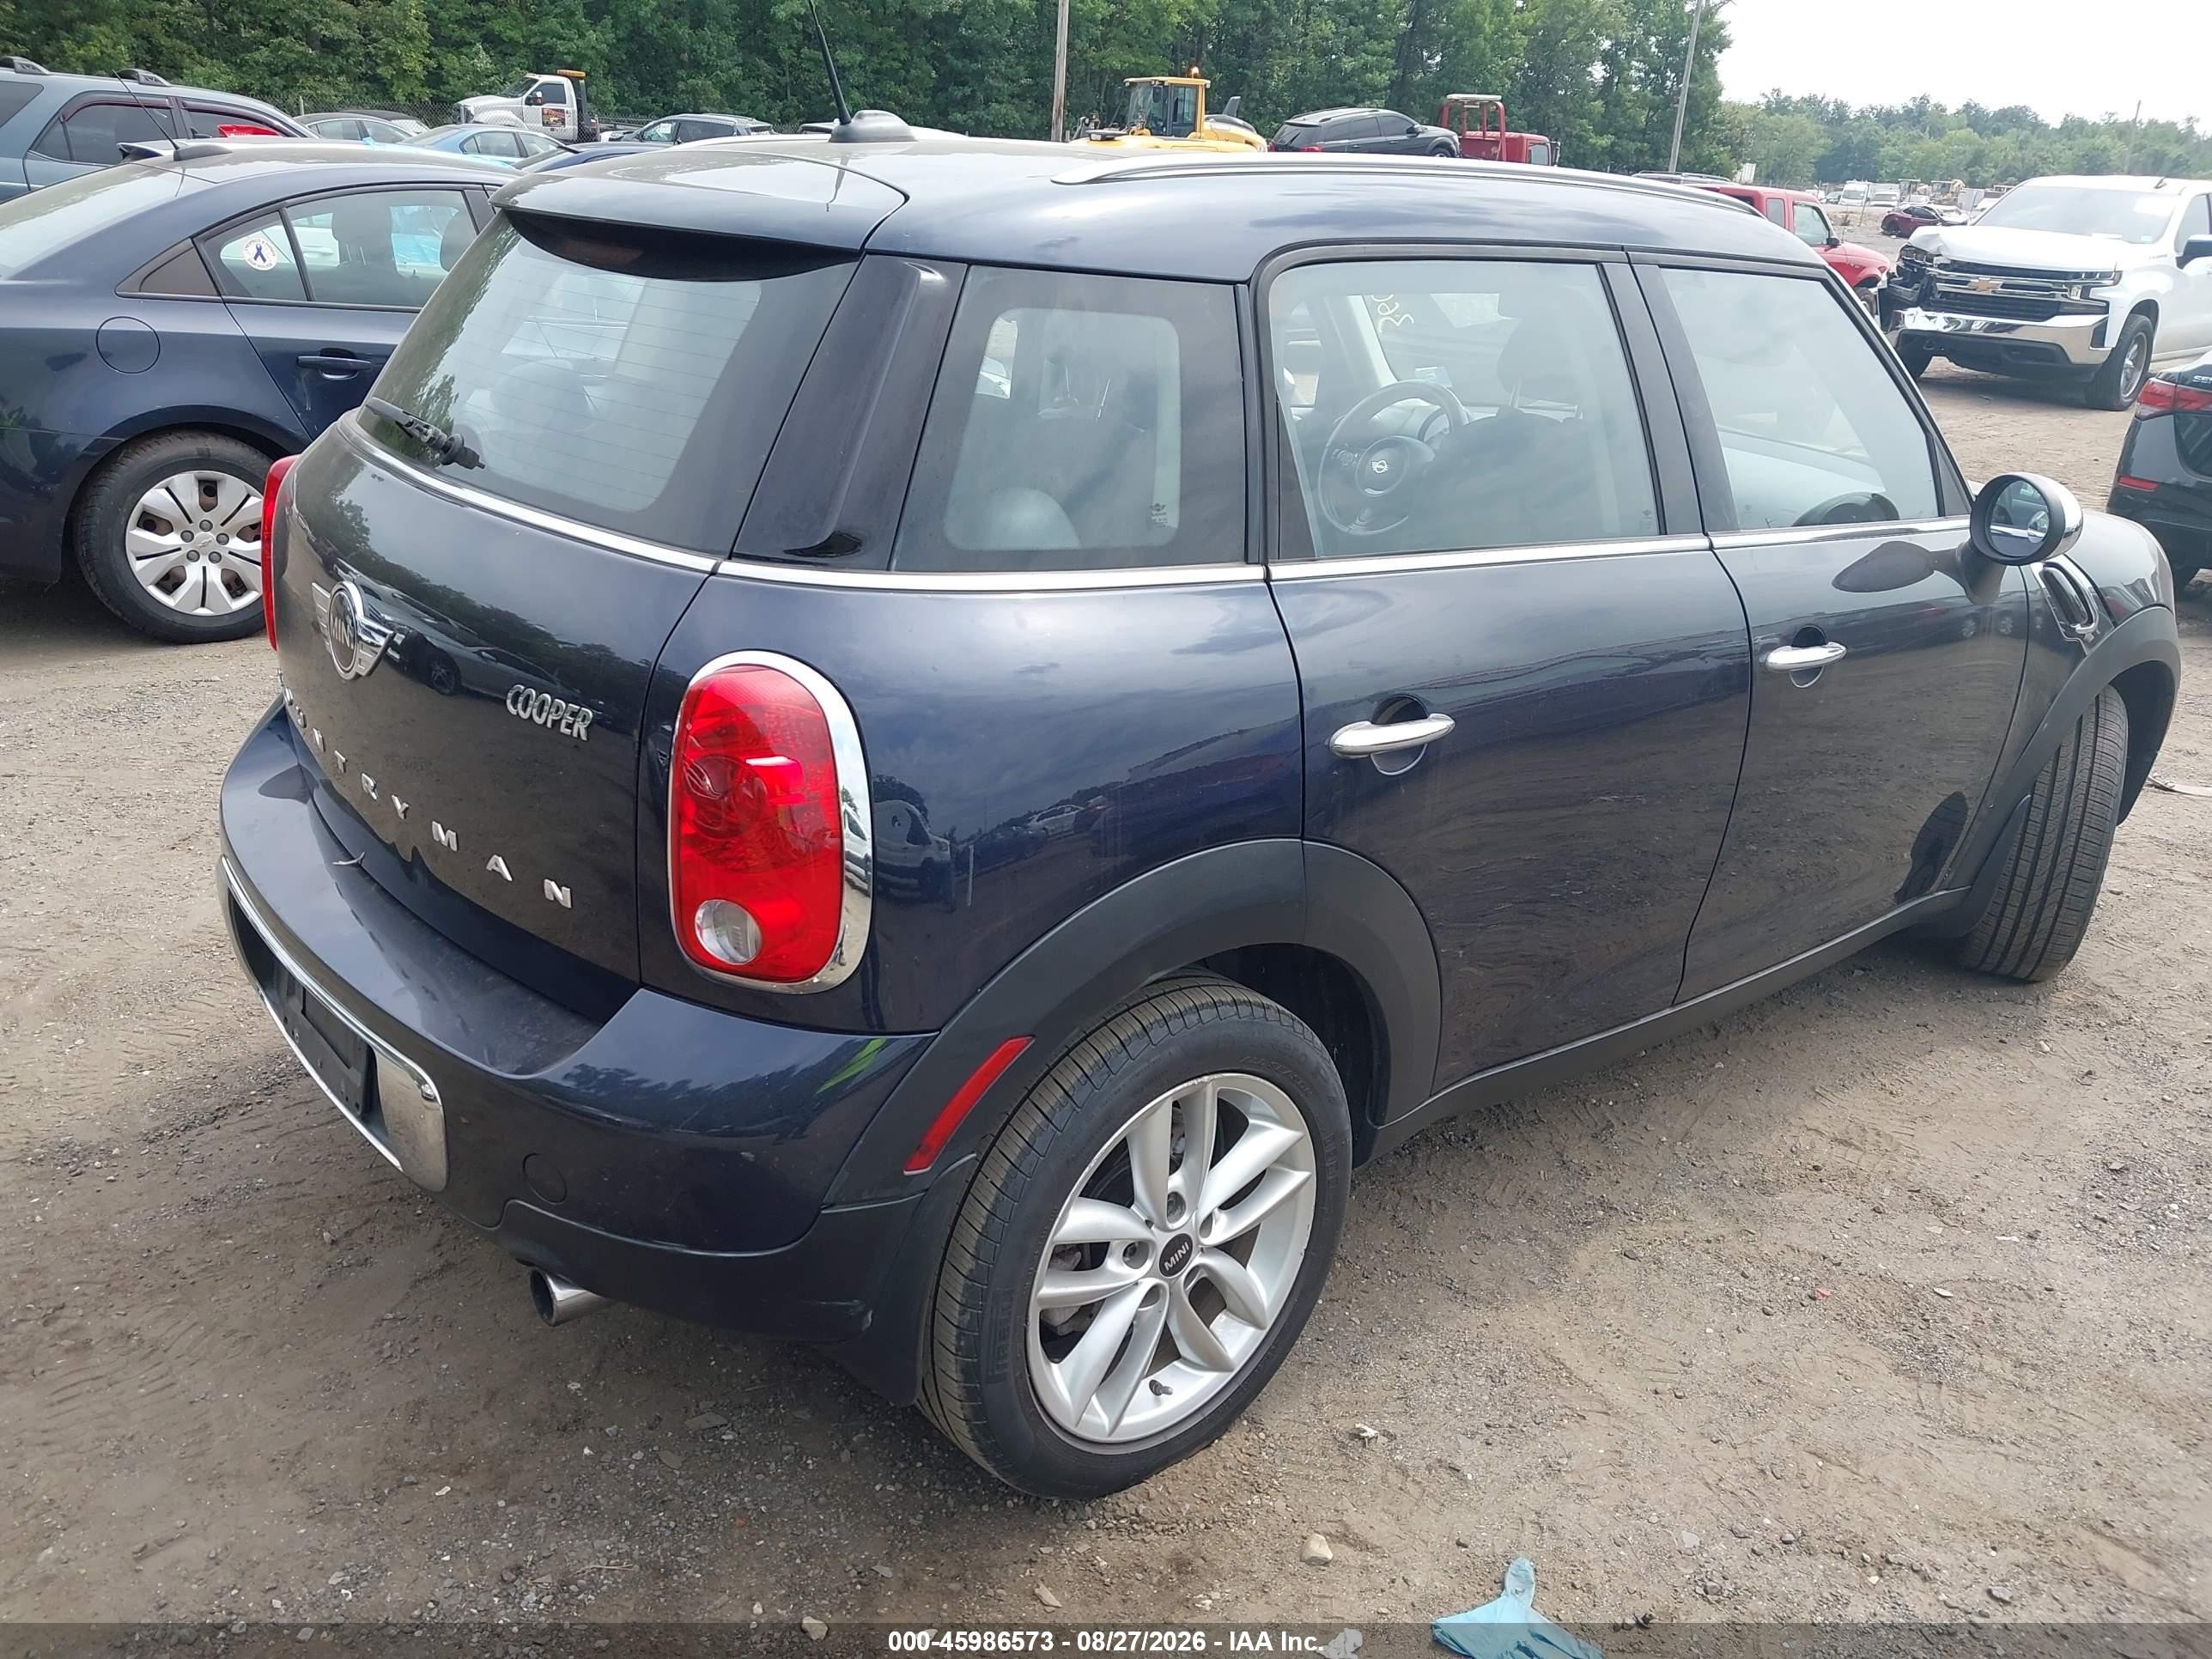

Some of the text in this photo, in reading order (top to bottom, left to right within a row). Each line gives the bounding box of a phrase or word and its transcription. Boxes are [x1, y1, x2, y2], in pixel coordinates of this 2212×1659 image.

[330, 612, 355, 650] MINI
[506, 684, 593, 741] COOPER
[1164, 1241, 1189, 1272] MINI
